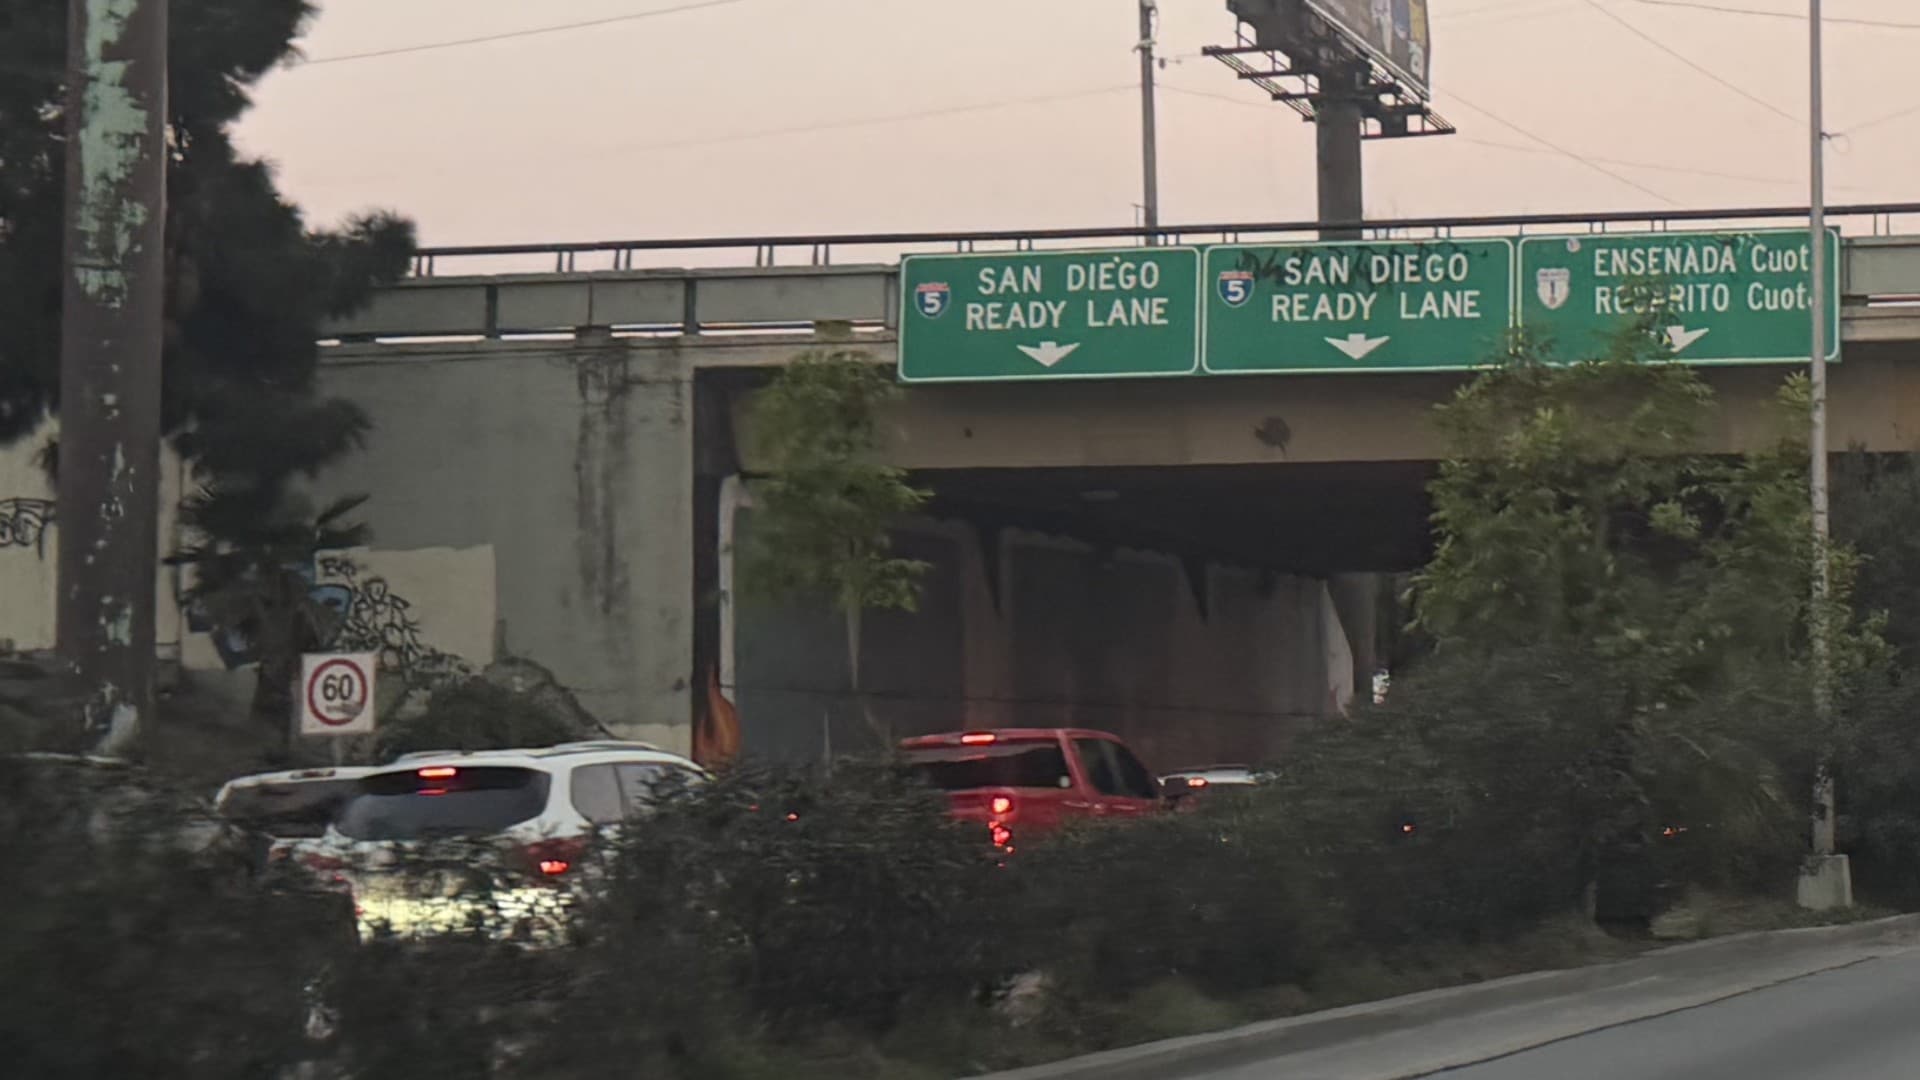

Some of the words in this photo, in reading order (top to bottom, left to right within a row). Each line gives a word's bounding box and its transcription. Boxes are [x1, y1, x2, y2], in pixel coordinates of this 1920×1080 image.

[1283, 255, 1349, 286] SAN
[1370, 252, 1469, 284] DIEGO
[1594, 245, 1737, 276] ENSENADA
[1750, 243, 1809, 272] Cuot
[977, 265, 1042, 295] SAN
[1066, 261, 1160, 292] DIEGO
[1227, 280, 1245, 302] 5
[924, 292, 941, 314] 5
[966, 300, 1067, 331] READY
[1087, 297, 1169, 328] LANE
[1271, 292, 1377, 322] READY
[1400, 290, 1481, 320] LANE
[1595, 283, 1730, 314] RORITO
[1747, 282, 1812, 310] Cuot
[322, 673, 354, 702] 60
